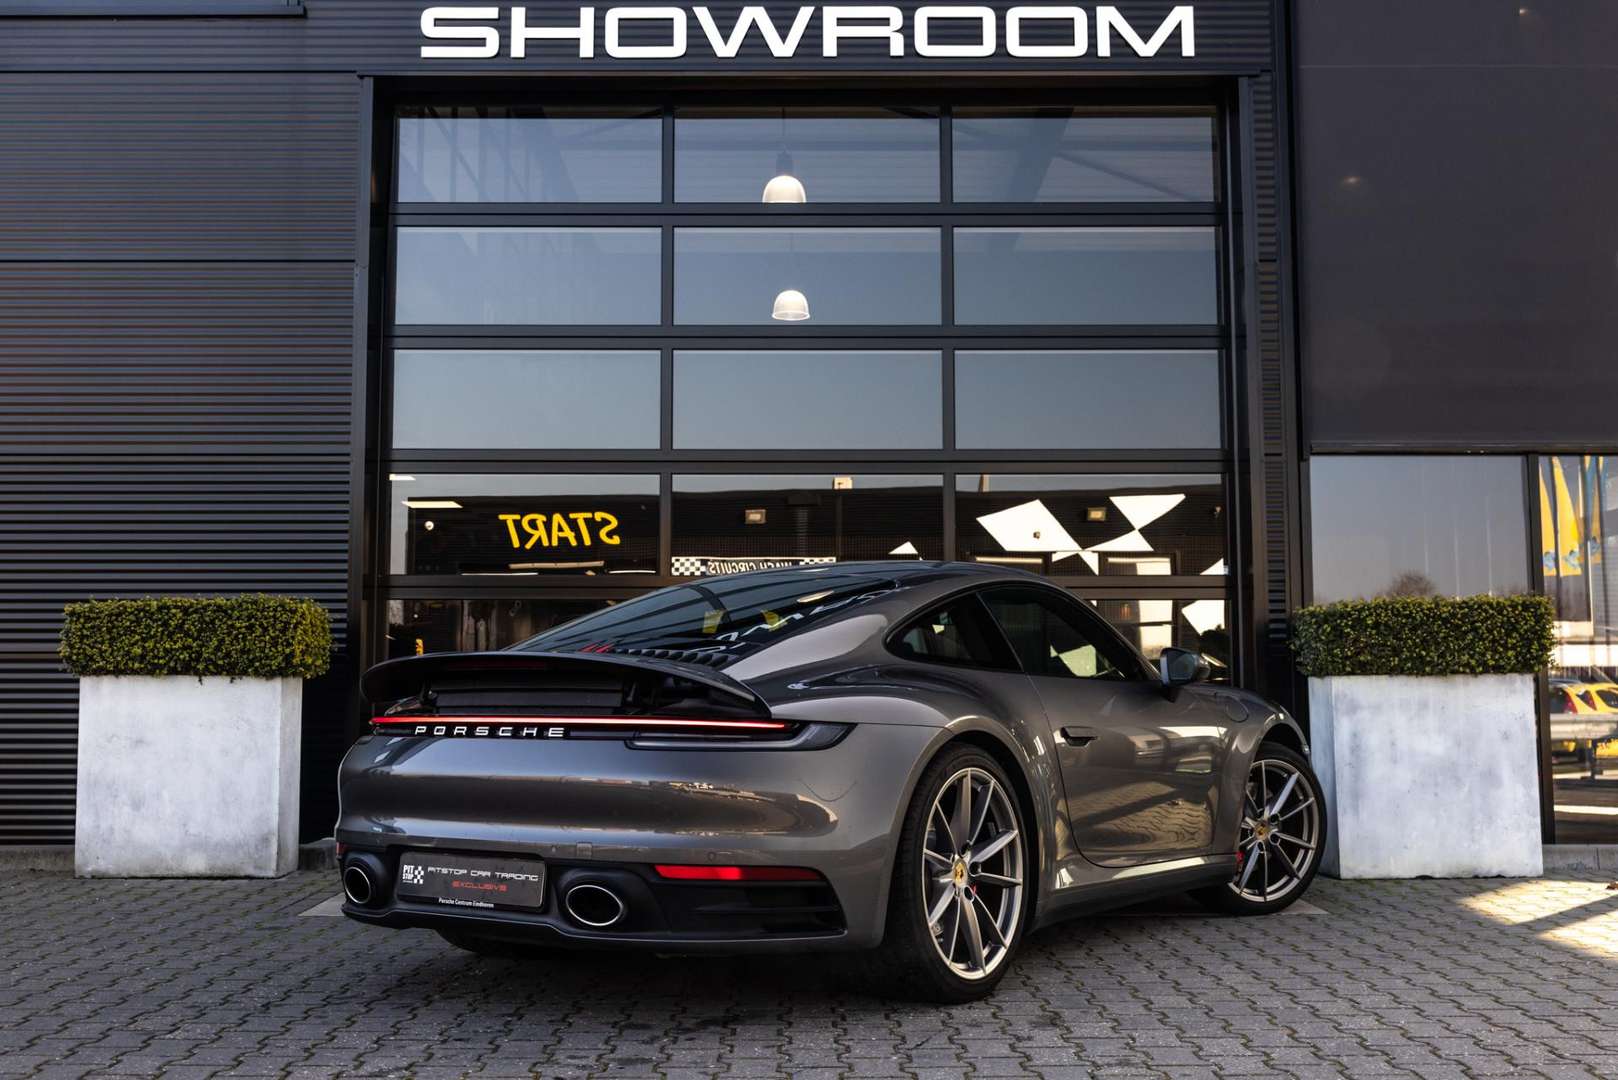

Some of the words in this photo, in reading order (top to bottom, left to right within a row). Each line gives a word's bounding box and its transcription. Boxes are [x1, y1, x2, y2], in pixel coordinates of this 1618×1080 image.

[419, 6, 1196, 58] SHOWROOM
[414, 725, 566, 738] PORSCHE
[403, 865, 414, 874] PIT
[427, 867, 467, 875] PITSTOP
[495, 872, 539, 881] TRADING
[452, 880, 508, 891] EXCLUSIVE
[438, 897, 454, 905] Porsche
